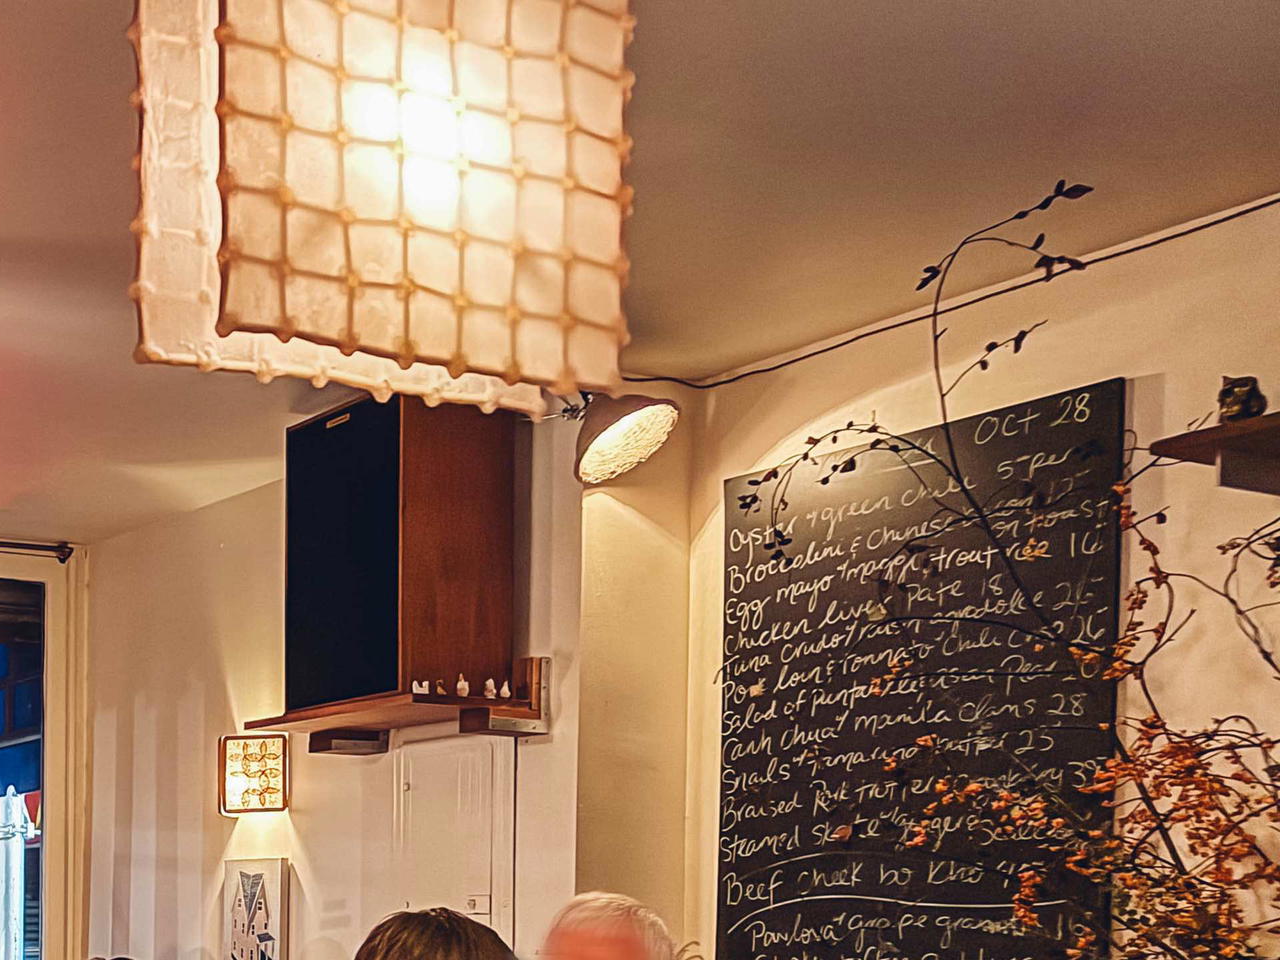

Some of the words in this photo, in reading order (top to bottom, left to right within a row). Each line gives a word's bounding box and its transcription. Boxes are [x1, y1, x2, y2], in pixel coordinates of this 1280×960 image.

[1050, 393, 1090, 426] 28
[820, 496, 892, 541] green
[725, 596, 771, 631] Egg
[776, 574, 834, 613] mayo
[725, 619, 814, 656] Chicken
[982, 573, 1004, 597] 18
[723, 656, 771, 681] Tuna
[721, 700, 777, 736] Salad
[784, 689, 808, 715] of
[722, 757, 790, 794] Snails
[722, 791, 803, 832] Braised
[811, 813, 880, 846] Skte
[722, 869, 783, 906] Beef
